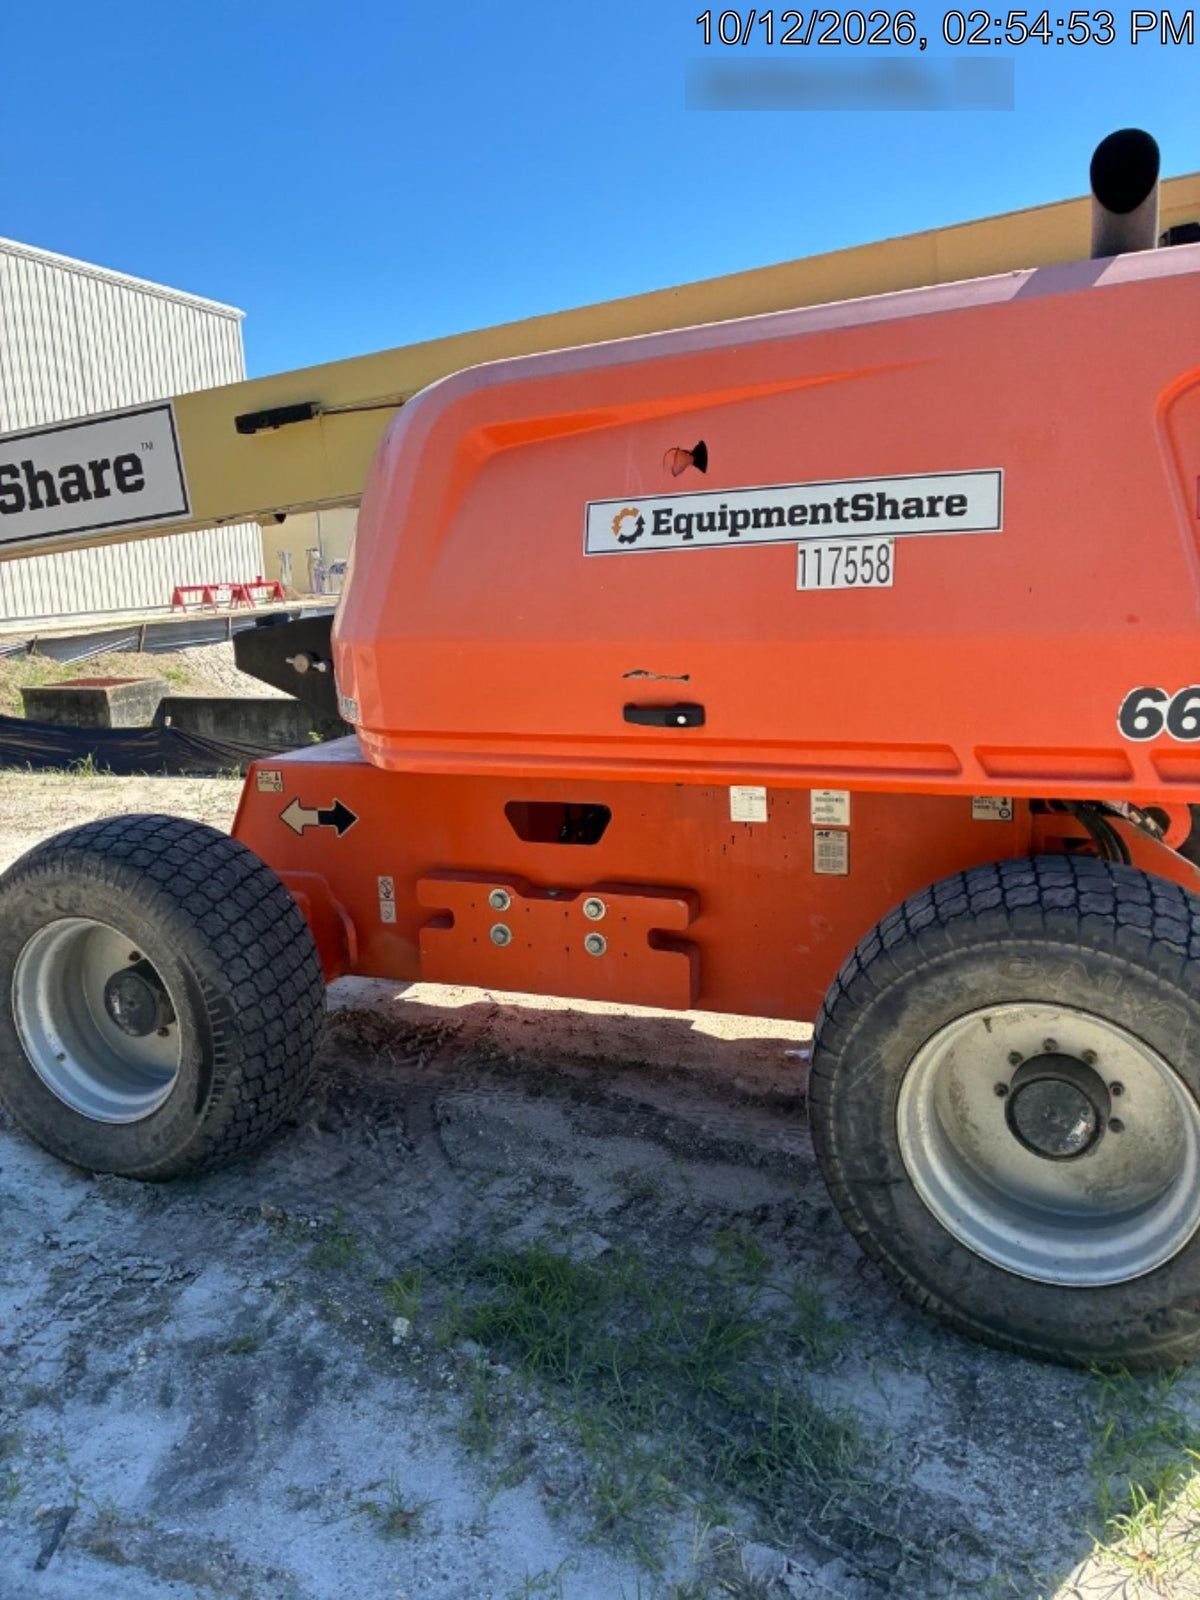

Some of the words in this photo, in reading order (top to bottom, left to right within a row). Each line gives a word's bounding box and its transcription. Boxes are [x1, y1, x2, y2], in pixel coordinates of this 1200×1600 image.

[0, 453, 145, 514] Share
[651, 492, 968, 540] EquipmentShare
[799, 544, 890, 587] 117558
